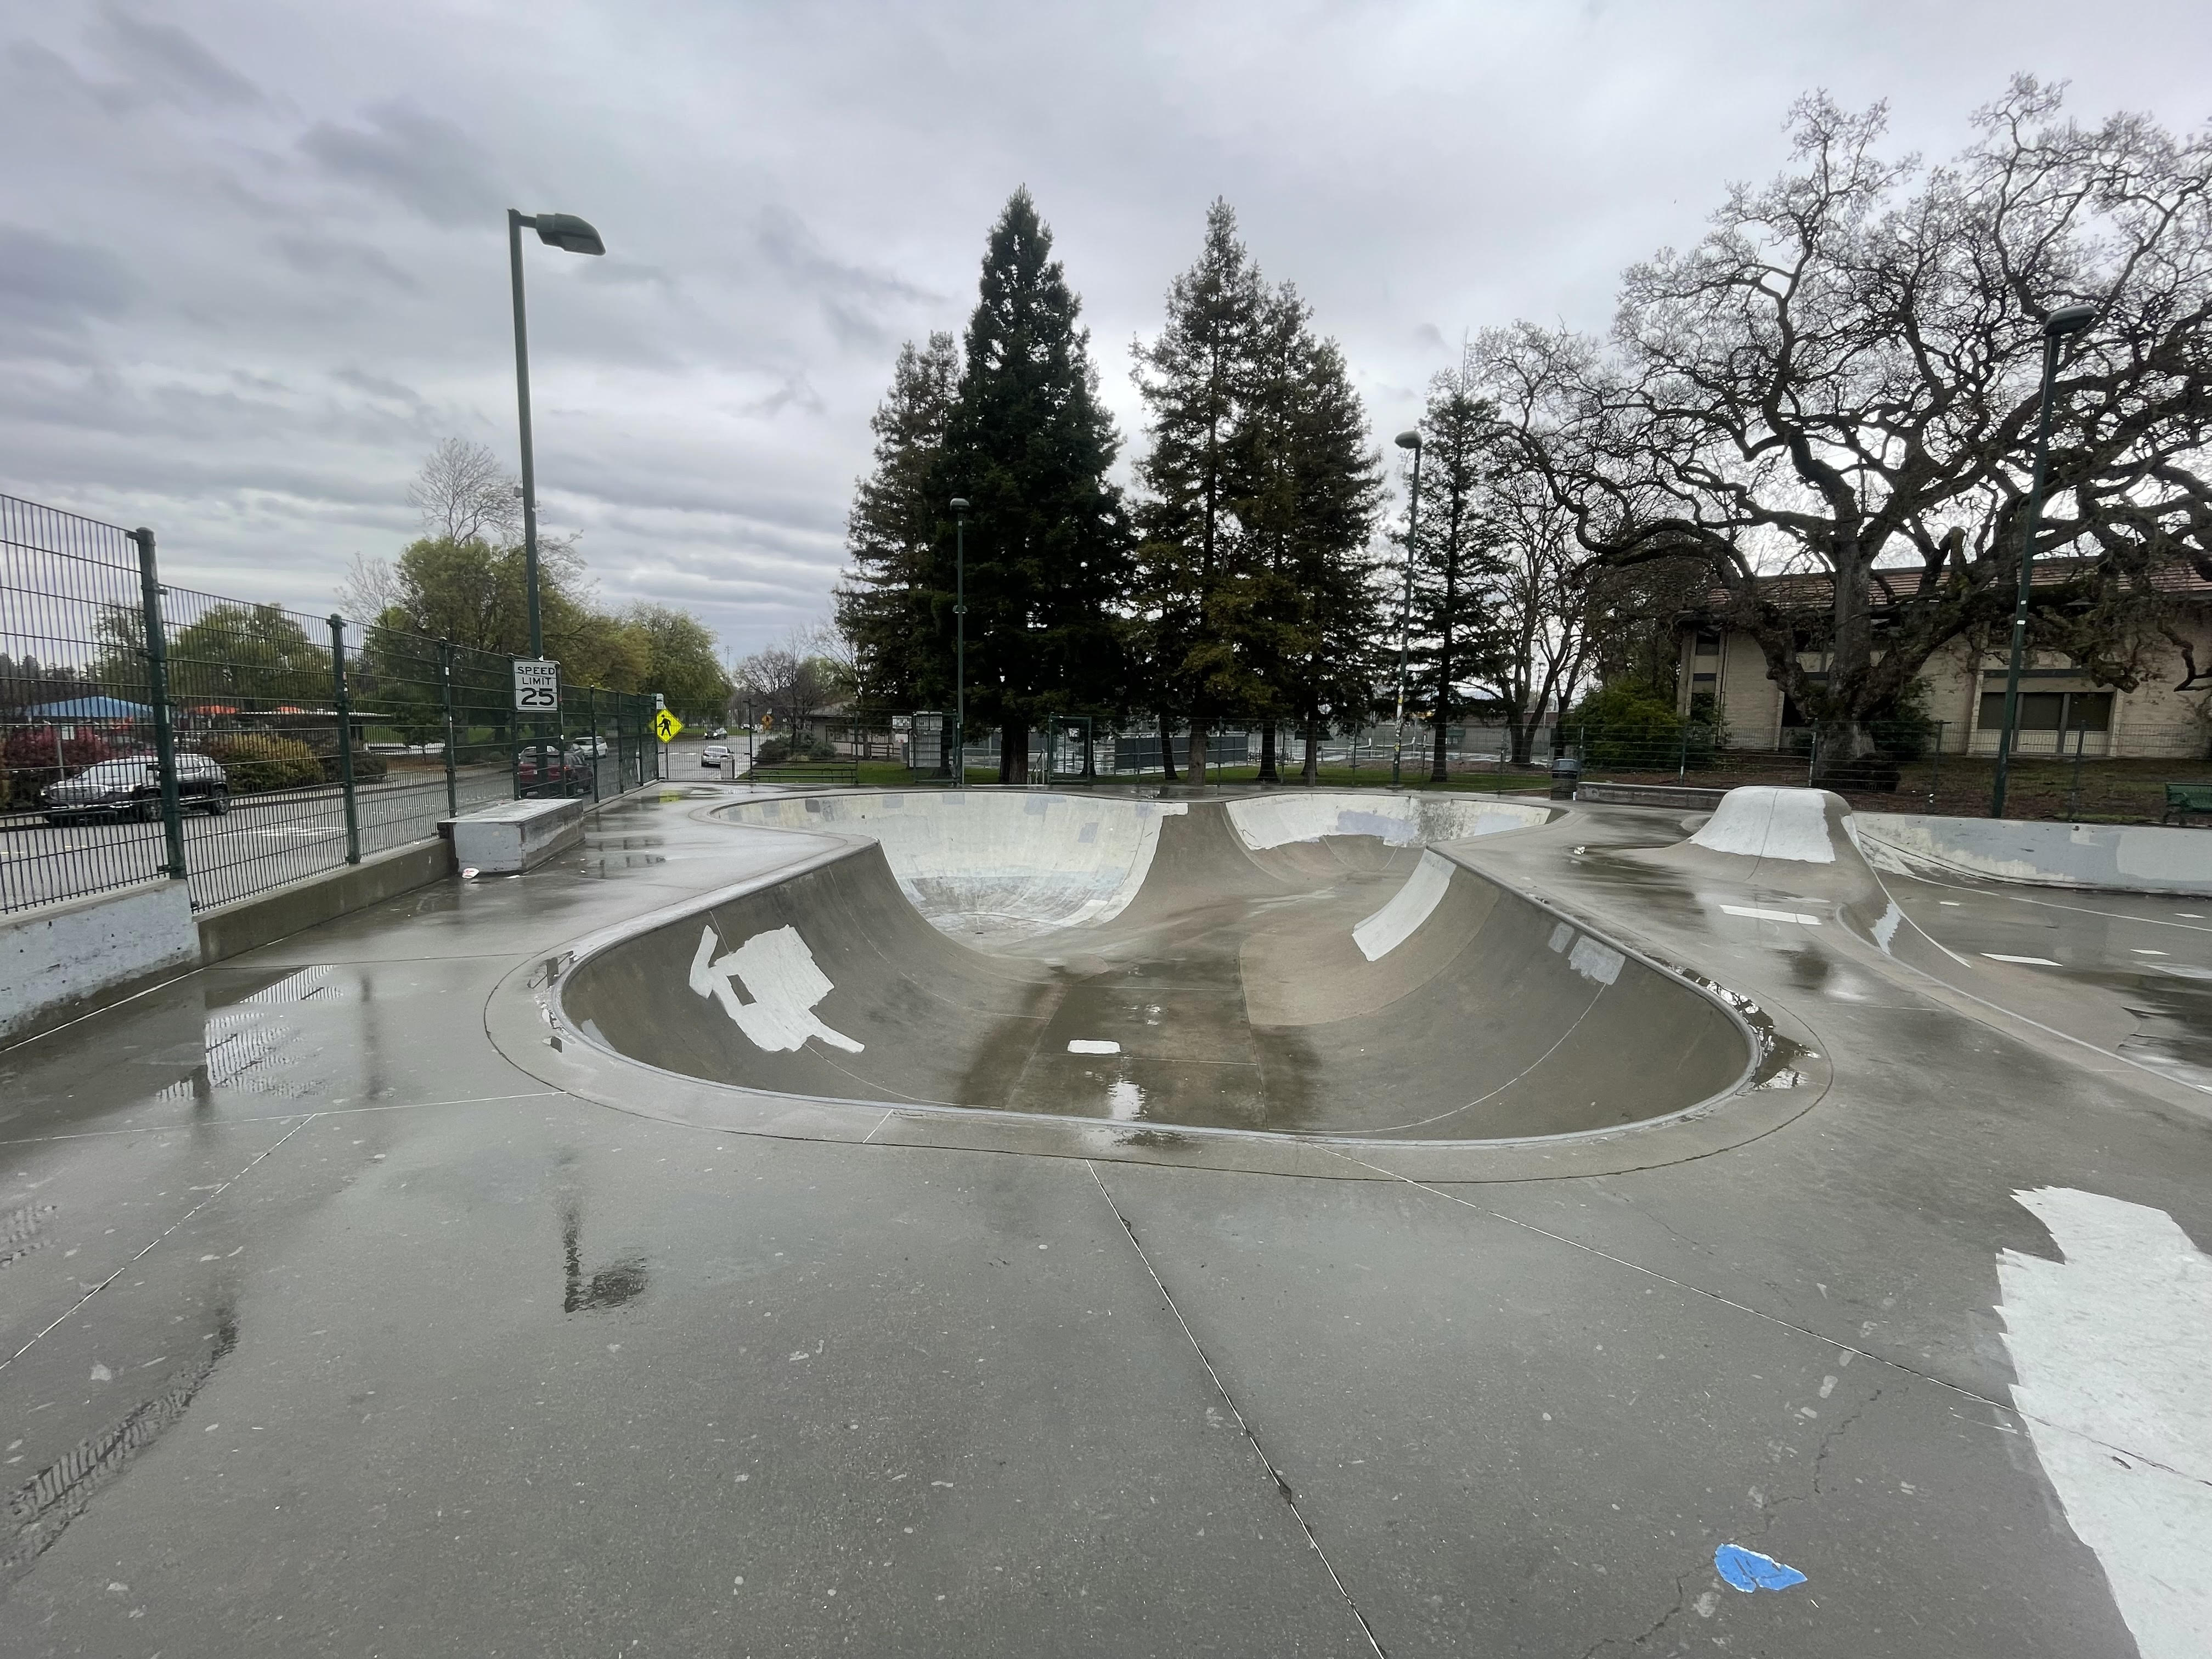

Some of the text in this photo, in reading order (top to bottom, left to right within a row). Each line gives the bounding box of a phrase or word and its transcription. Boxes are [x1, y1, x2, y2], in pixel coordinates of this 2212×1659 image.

[518, 667, 555, 675] SPEED
[522, 677, 551, 685] LIMIT
[522, 687, 554, 706] 25
